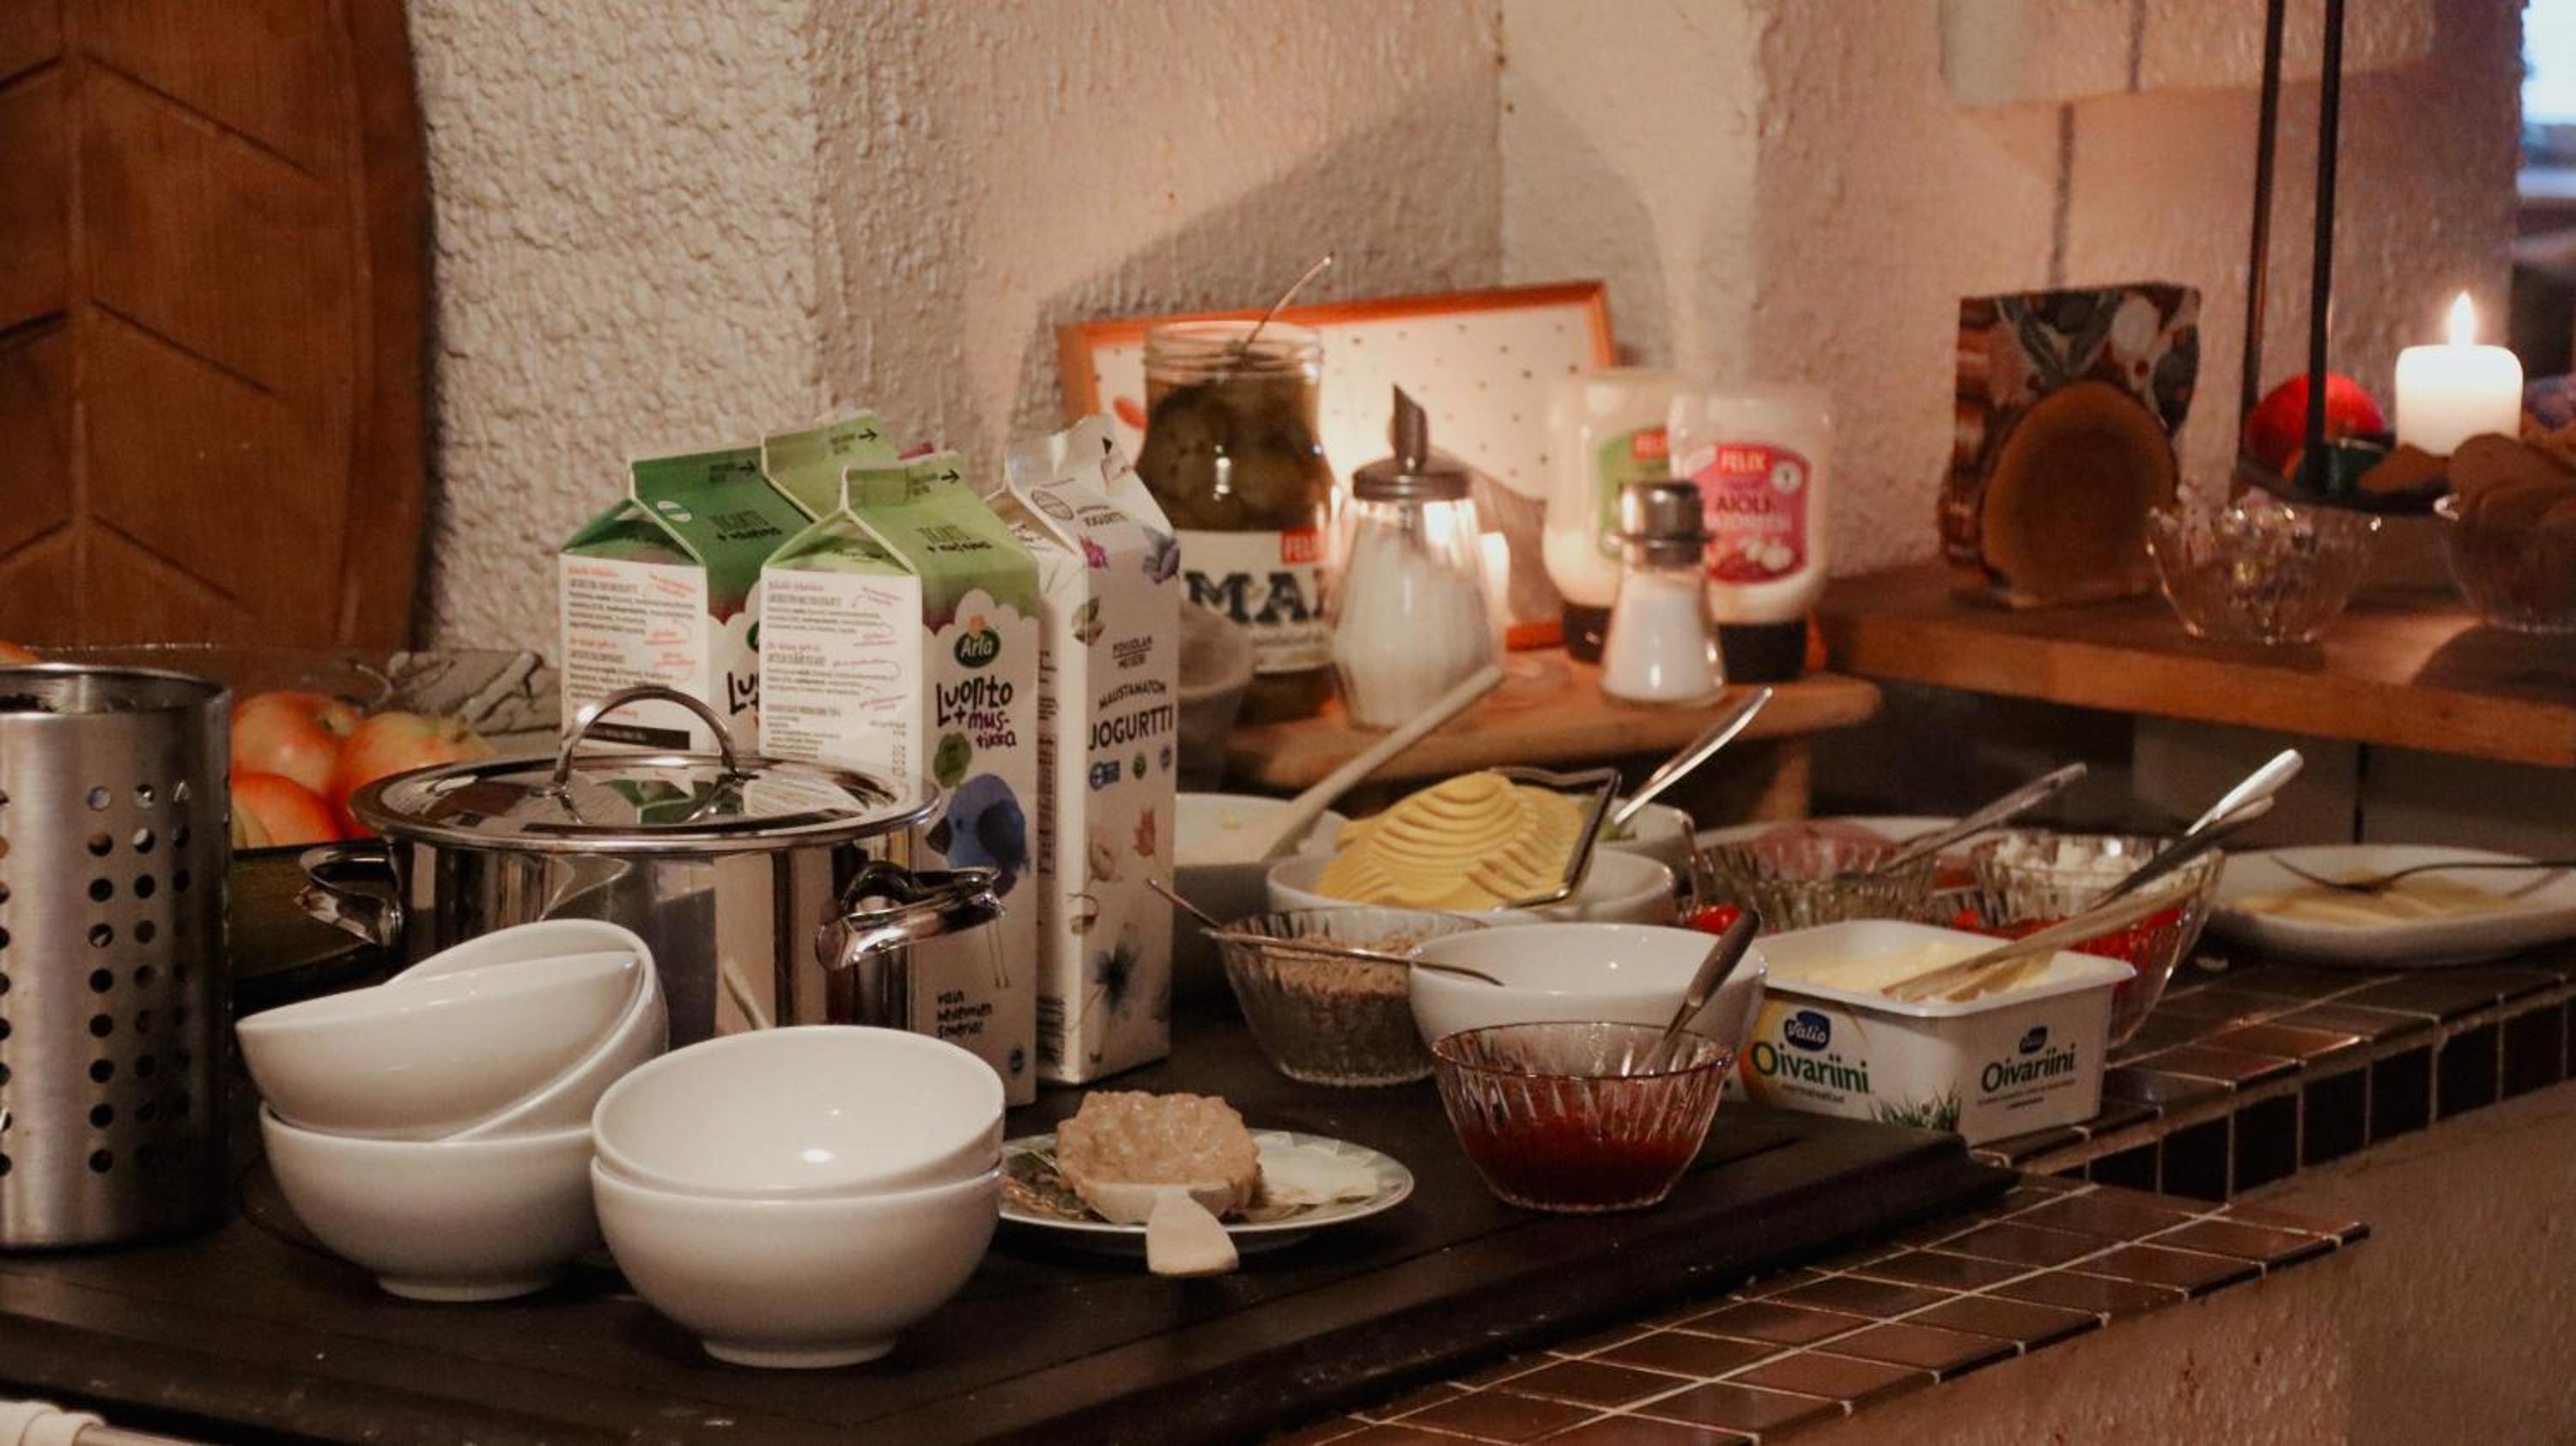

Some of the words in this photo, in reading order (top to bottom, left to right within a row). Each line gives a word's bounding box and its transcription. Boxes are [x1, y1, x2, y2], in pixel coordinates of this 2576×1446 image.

[1721, 449, 1766, 474] FELIX
[960, 635, 994, 659] Arla
[726, 671, 759, 716] Lu
[936, 674, 1014, 727] Luonto
[1098, 680, 1167, 710] MAUSTAMATON
[1087, 704, 1174, 752] JOGURTTI
[1786, 1019, 1828, 1045] Valio
[1751, 1040, 1870, 1094] Oivariini
[1980, 1042, 2076, 1093] Oivariini
